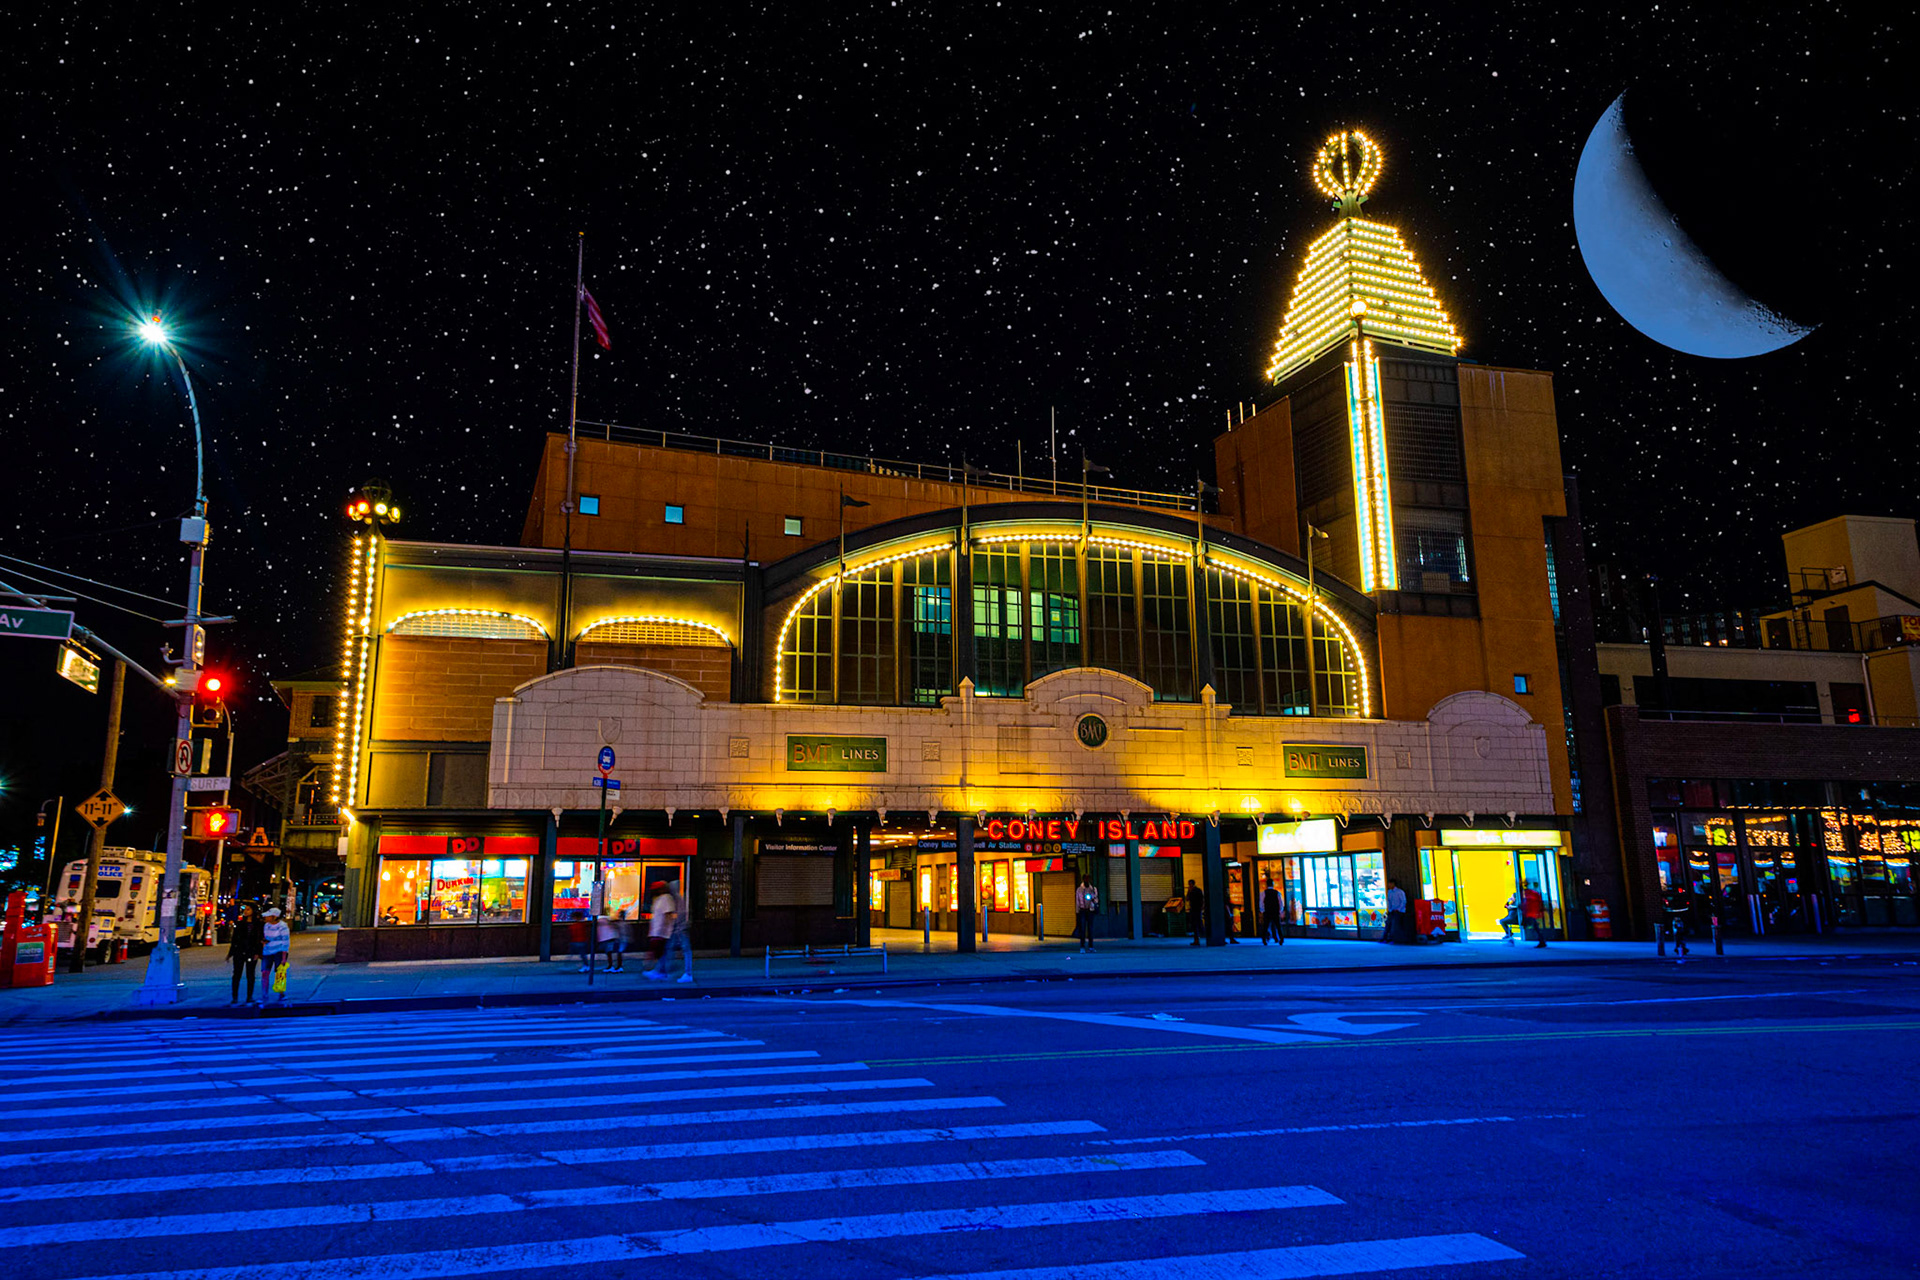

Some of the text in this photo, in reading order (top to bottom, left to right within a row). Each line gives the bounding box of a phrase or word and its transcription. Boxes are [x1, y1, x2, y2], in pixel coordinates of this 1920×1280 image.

[1080, 719, 1103, 741] BMT
[793, 743, 880, 764] BMT LINES
[1289, 752, 1361, 771] BMT LINES
[191, 778, 220, 790] SURF
[987, 819, 1196, 840] CONEY ISLAND
[452, 837, 480, 854] DD
[612, 839, 636, 855] DD
[918, 840, 939, 849] Coney
[941, 840, 957, 848] Islan
[988, 841, 997, 849] Av
[998, 841, 1021, 849] Station
